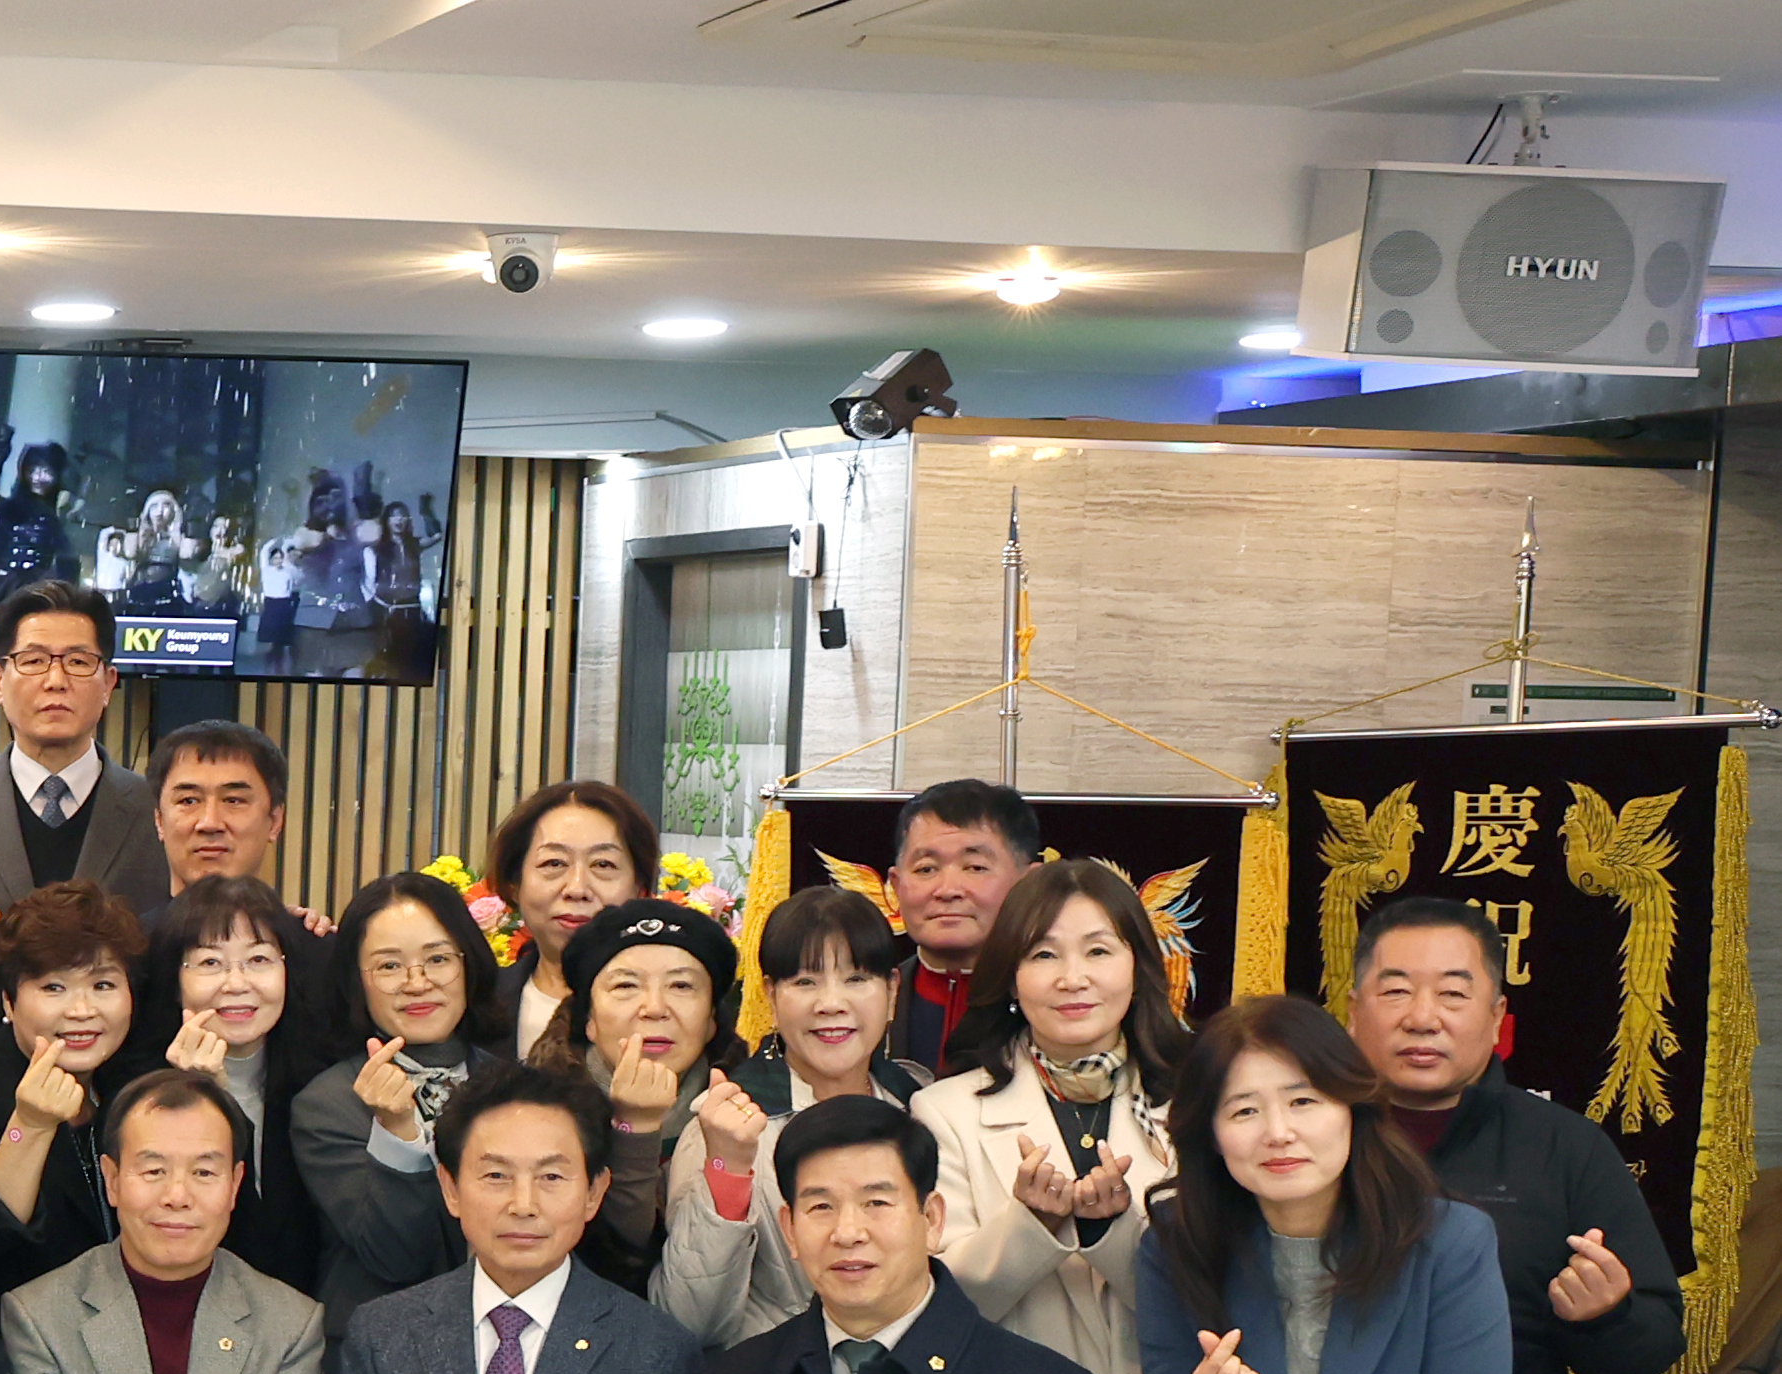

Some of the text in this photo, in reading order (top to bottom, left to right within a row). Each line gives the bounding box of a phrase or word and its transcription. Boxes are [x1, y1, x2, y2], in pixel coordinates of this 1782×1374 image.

[1506, 256, 1600, 280] HYUN
[123, 627, 164, 652] KY
[167, 628, 229, 644] Keumyoung
[165, 641, 199, 655] Group
